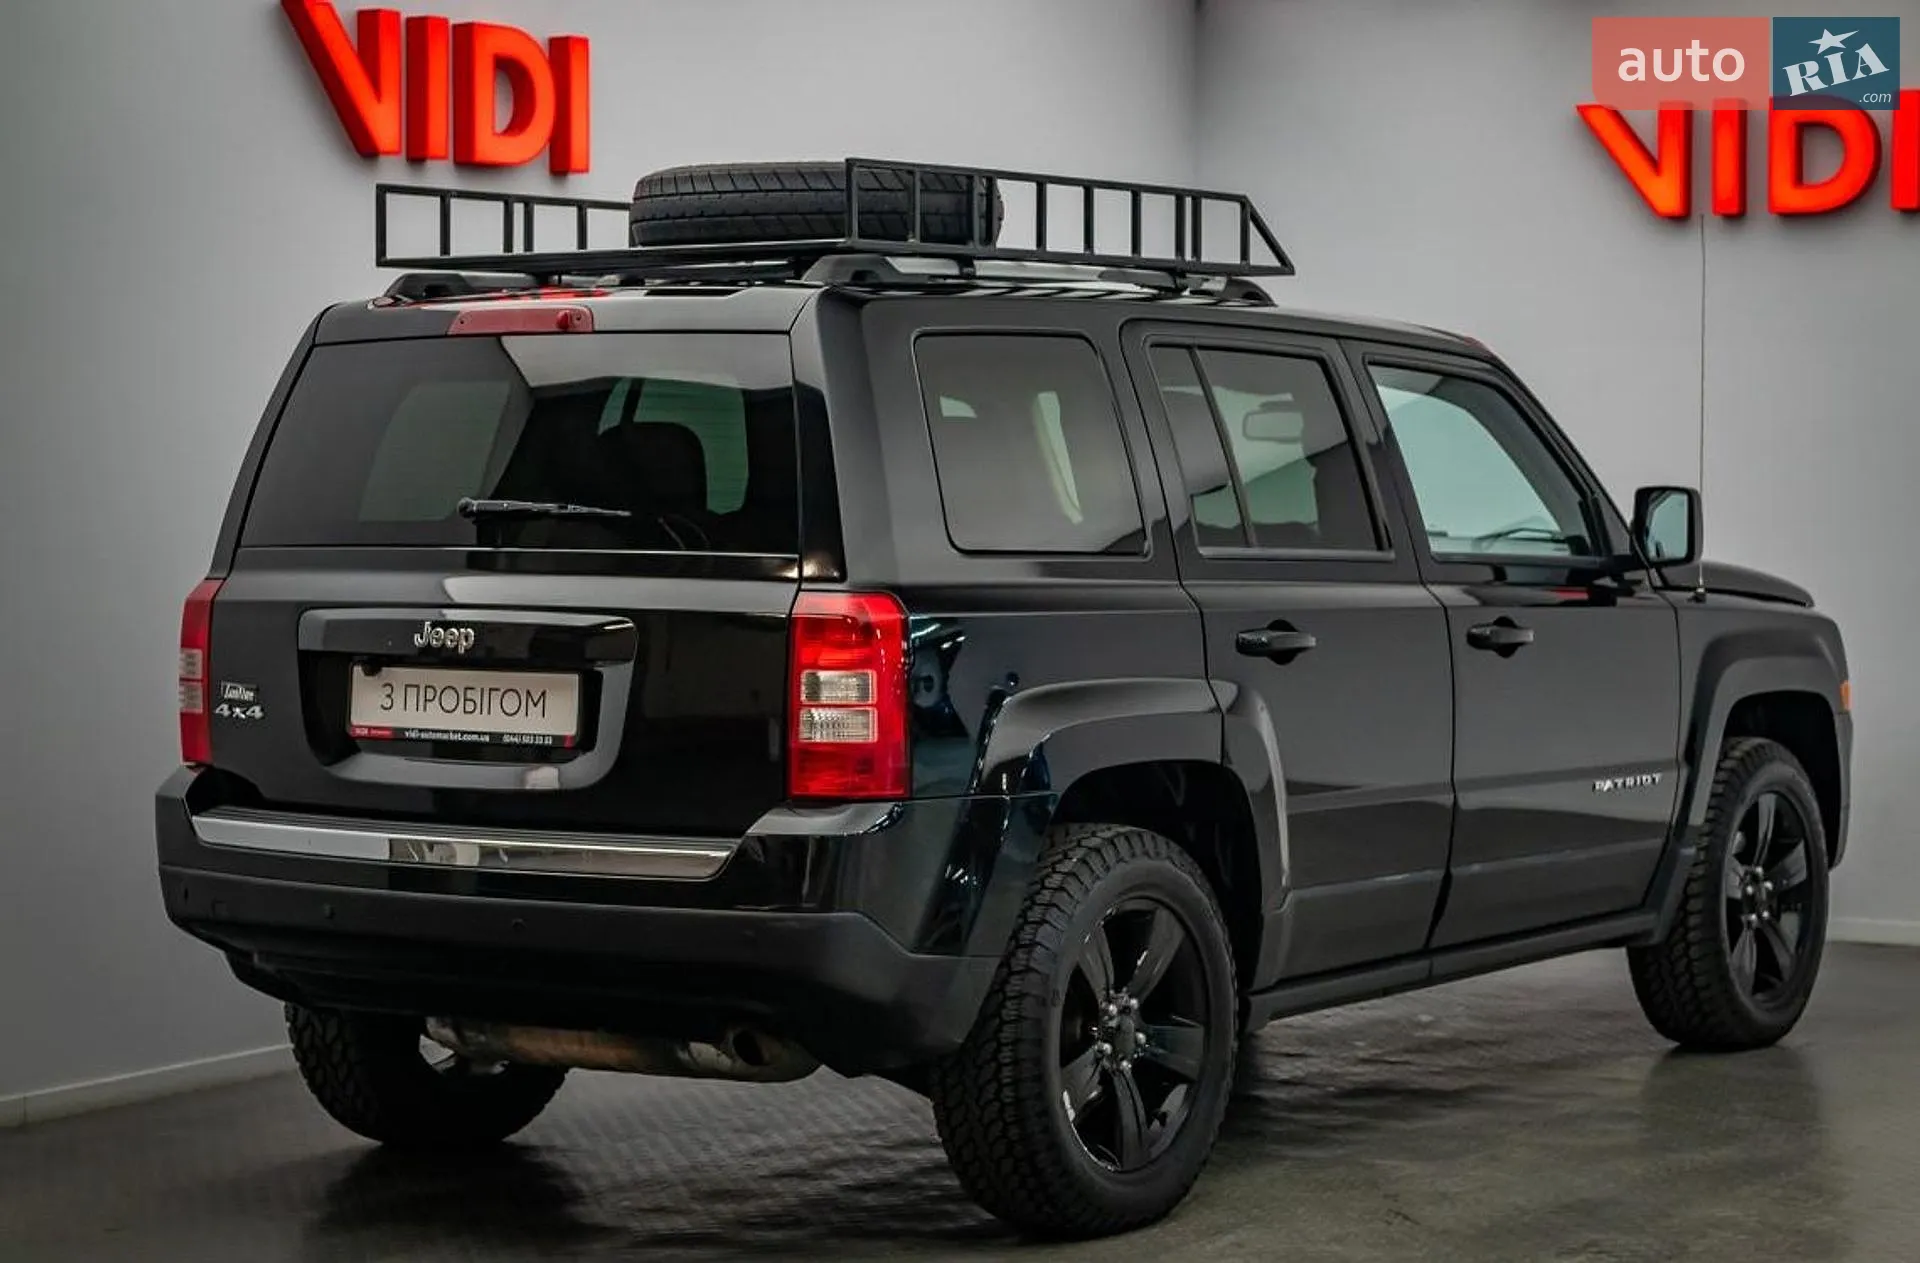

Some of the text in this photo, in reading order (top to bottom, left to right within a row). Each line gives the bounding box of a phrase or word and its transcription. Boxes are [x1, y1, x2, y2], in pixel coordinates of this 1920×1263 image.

[279, 0, 590, 174] VIDI
[1576, 88, 1920, 219] VIDI
[414, 621, 475, 654] Jeep
[403, 684, 547, 718] ПРОБІГОМ
